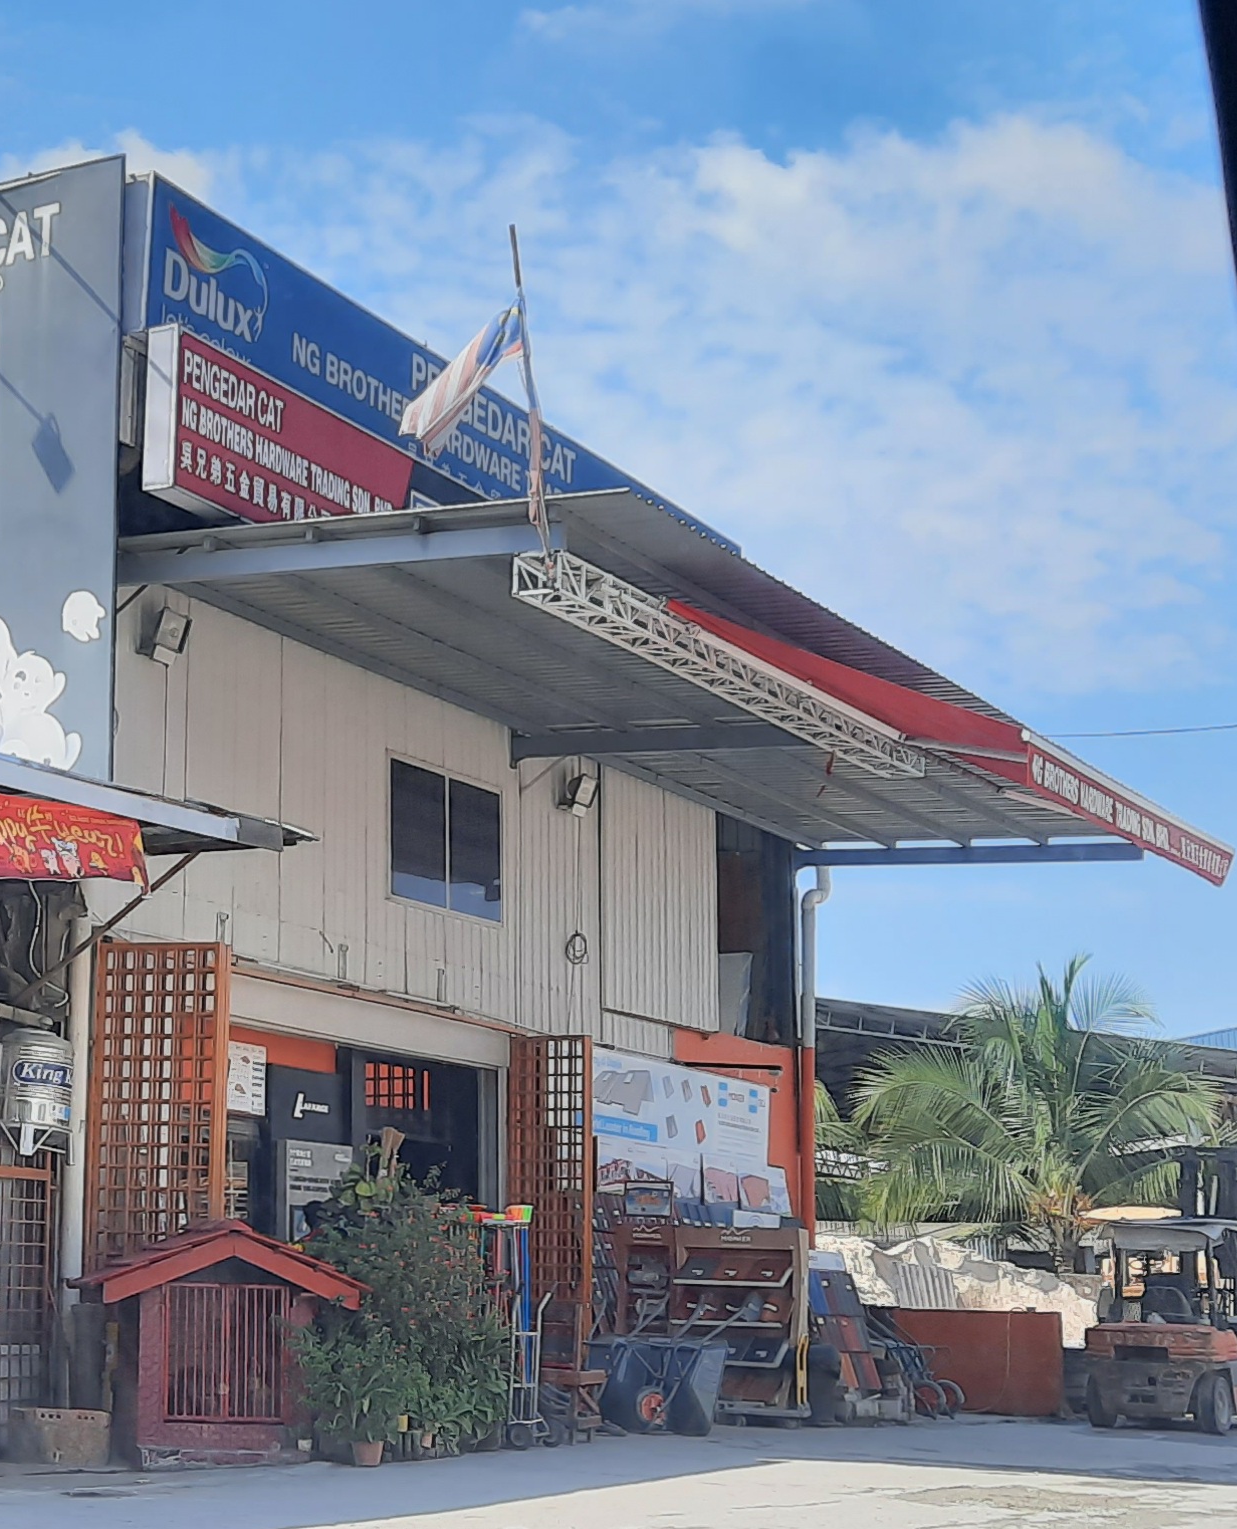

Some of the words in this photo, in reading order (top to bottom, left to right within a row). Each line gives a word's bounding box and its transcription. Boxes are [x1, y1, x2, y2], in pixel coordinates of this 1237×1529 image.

[164, 248, 253, 343] Dulux
[183, 349, 255, 420] PENGEDAR
[257, 391, 284, 433] CAT
[292, 332, 320, 376] NG
[325, 353, 413, 422] BROTHE
[444, 430, 522, 492] ARDWARE
[182, 396, 197, 432] NG
[199, 404, 253, 460] BROTHERS
[256, 436, 308, 487] HARDWARE
[311, 463, 350, 509] TRADING
[20, 1063, 63, 1085] King
